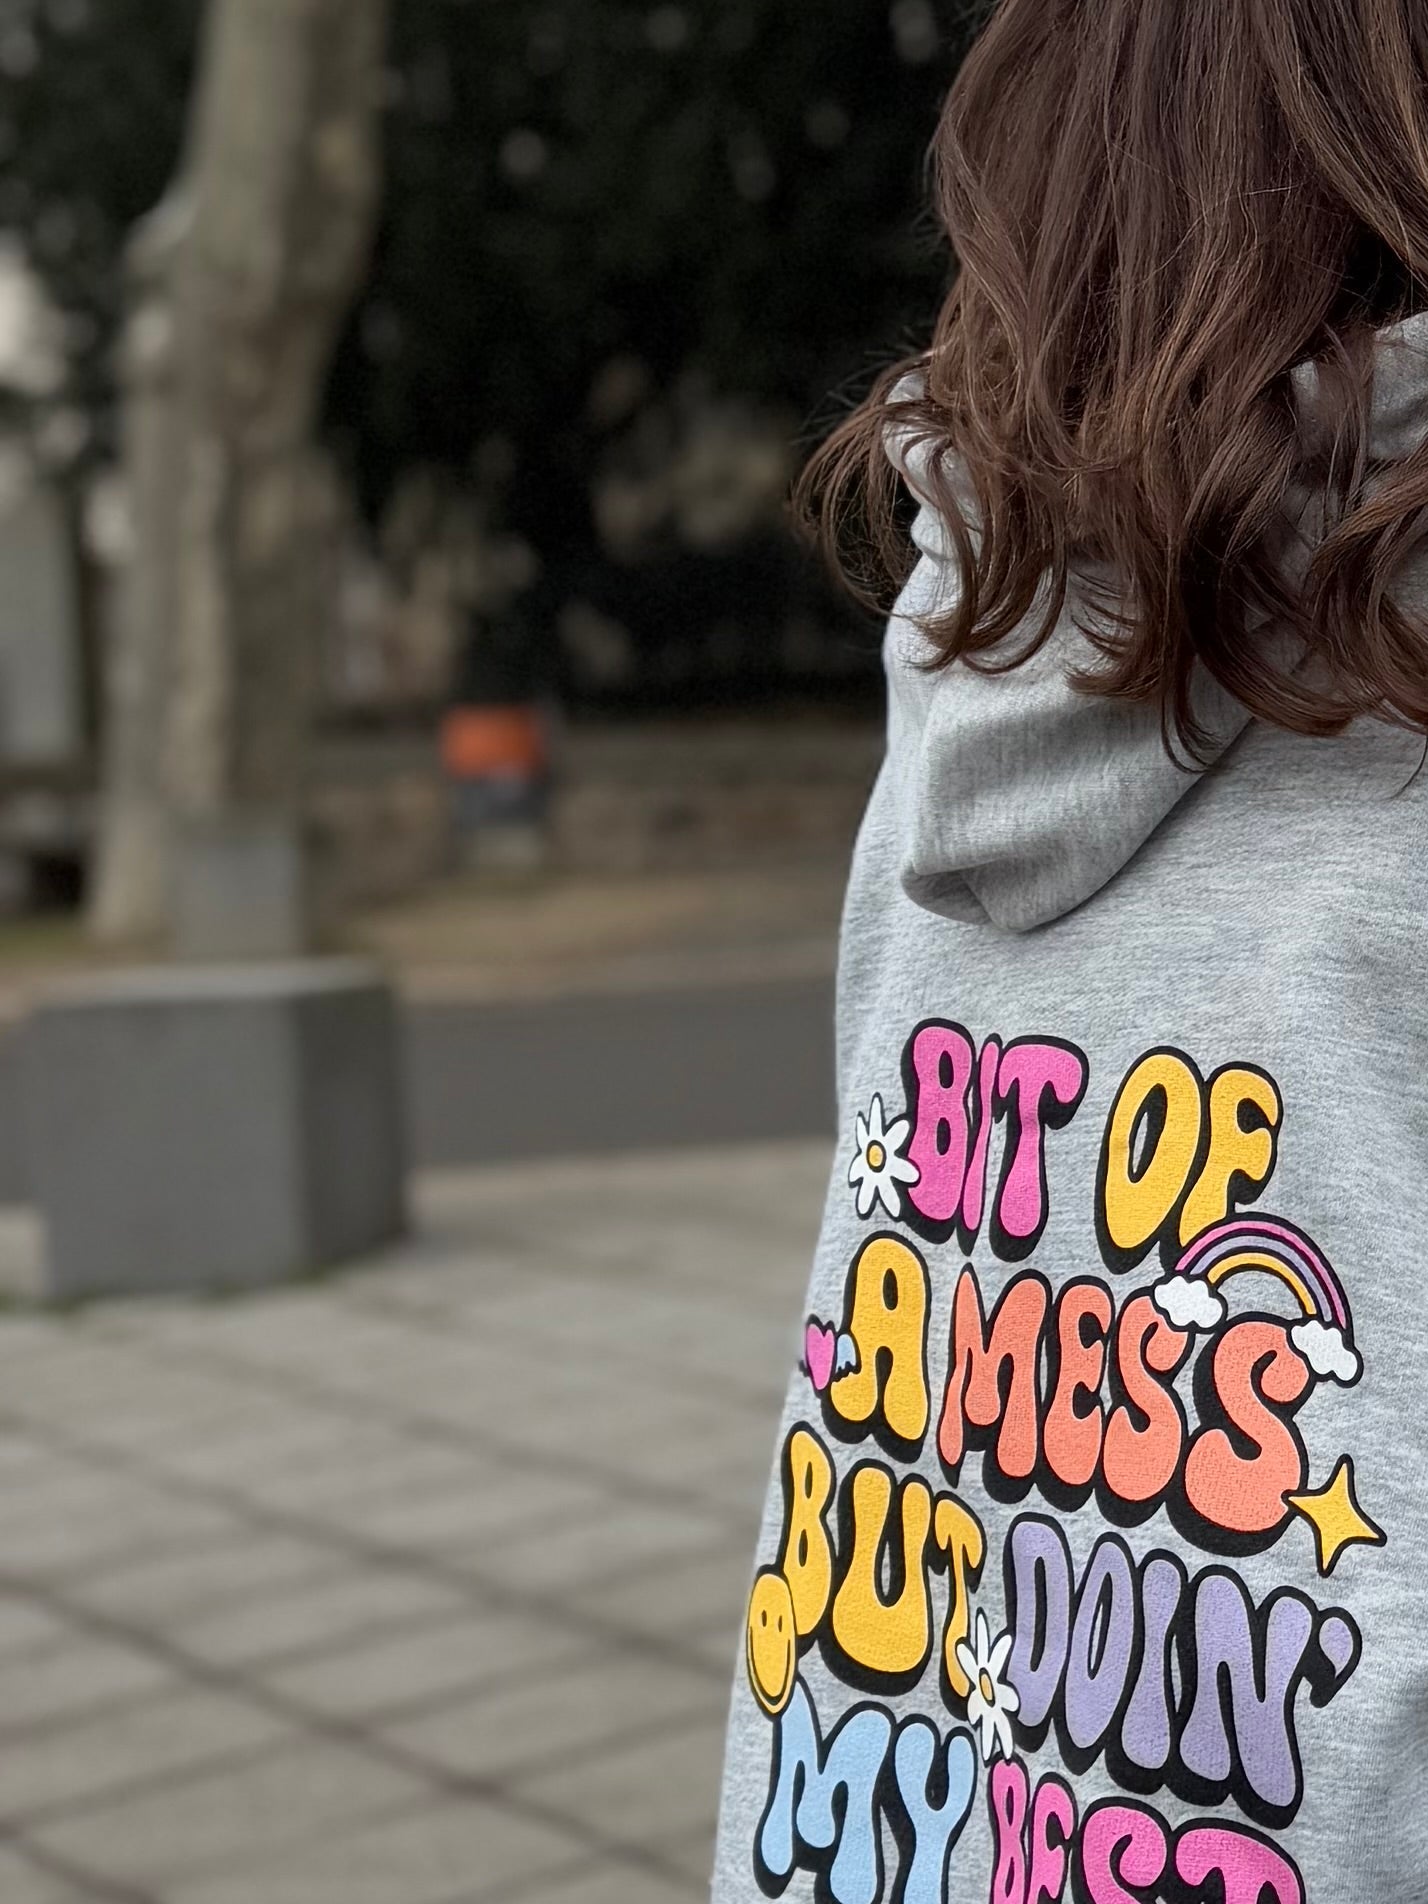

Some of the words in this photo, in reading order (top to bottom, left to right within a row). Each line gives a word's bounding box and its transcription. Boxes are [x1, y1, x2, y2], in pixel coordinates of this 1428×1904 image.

[900, 1017, 1087, 1254] BIT
[1099, 1045, 1283, 1263] OF
[824, 1230, 929, 1444] A
[934, 1262, 1322, 1558] MESS
[780, 1418, 984, 1702] BUT
[1000, 1511, 1362, 1831] DOIN'
